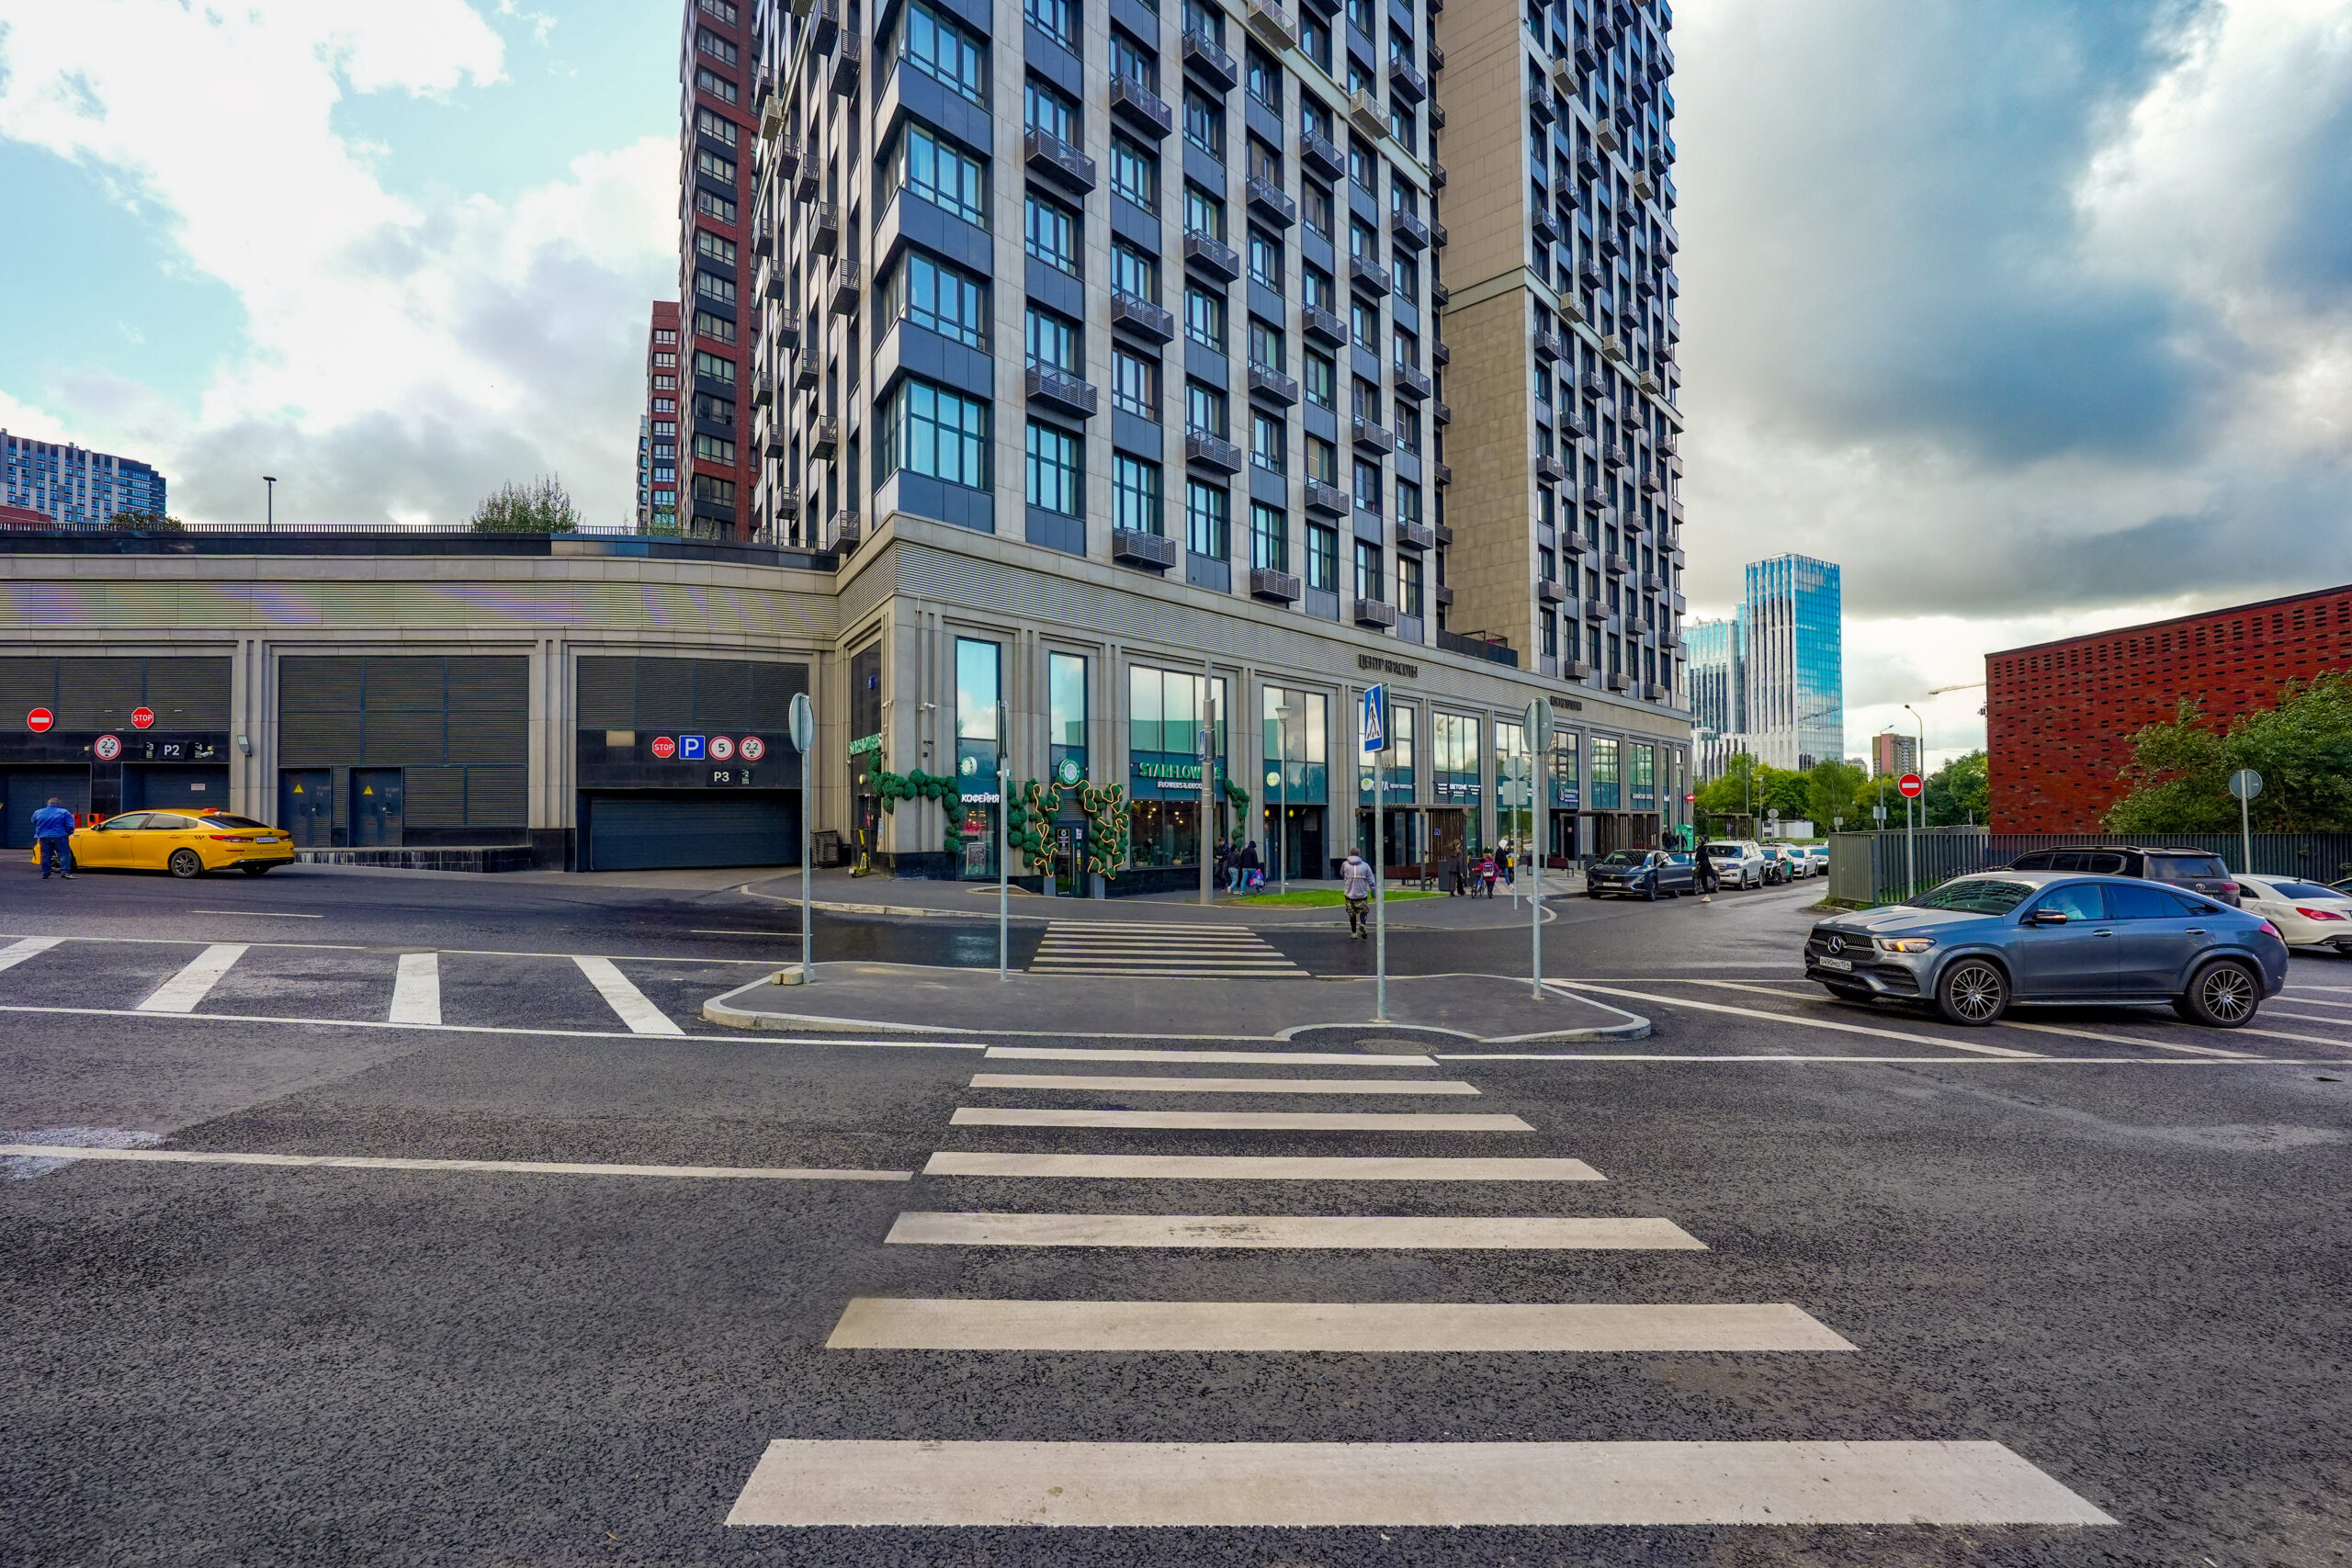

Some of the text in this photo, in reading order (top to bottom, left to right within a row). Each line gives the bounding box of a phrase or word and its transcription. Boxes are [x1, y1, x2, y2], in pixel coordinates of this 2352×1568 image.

[133, 714, 153, 722] STOP
[164, 745, 180, 756] P2
[654, 743, 673, 751] STOP
[685, 738, 699, 757] P
[718, 743, 725, 752] 5
[714, 771, 729, 782] P3
[1139, 762, 1221, 780] STARFLOWS
[1158, 781, 1183, 789] FLOWERS
[1187, 782, 1203, 790] DECO
[961, 792, 1000, 804] КОФЕЙНЯ
